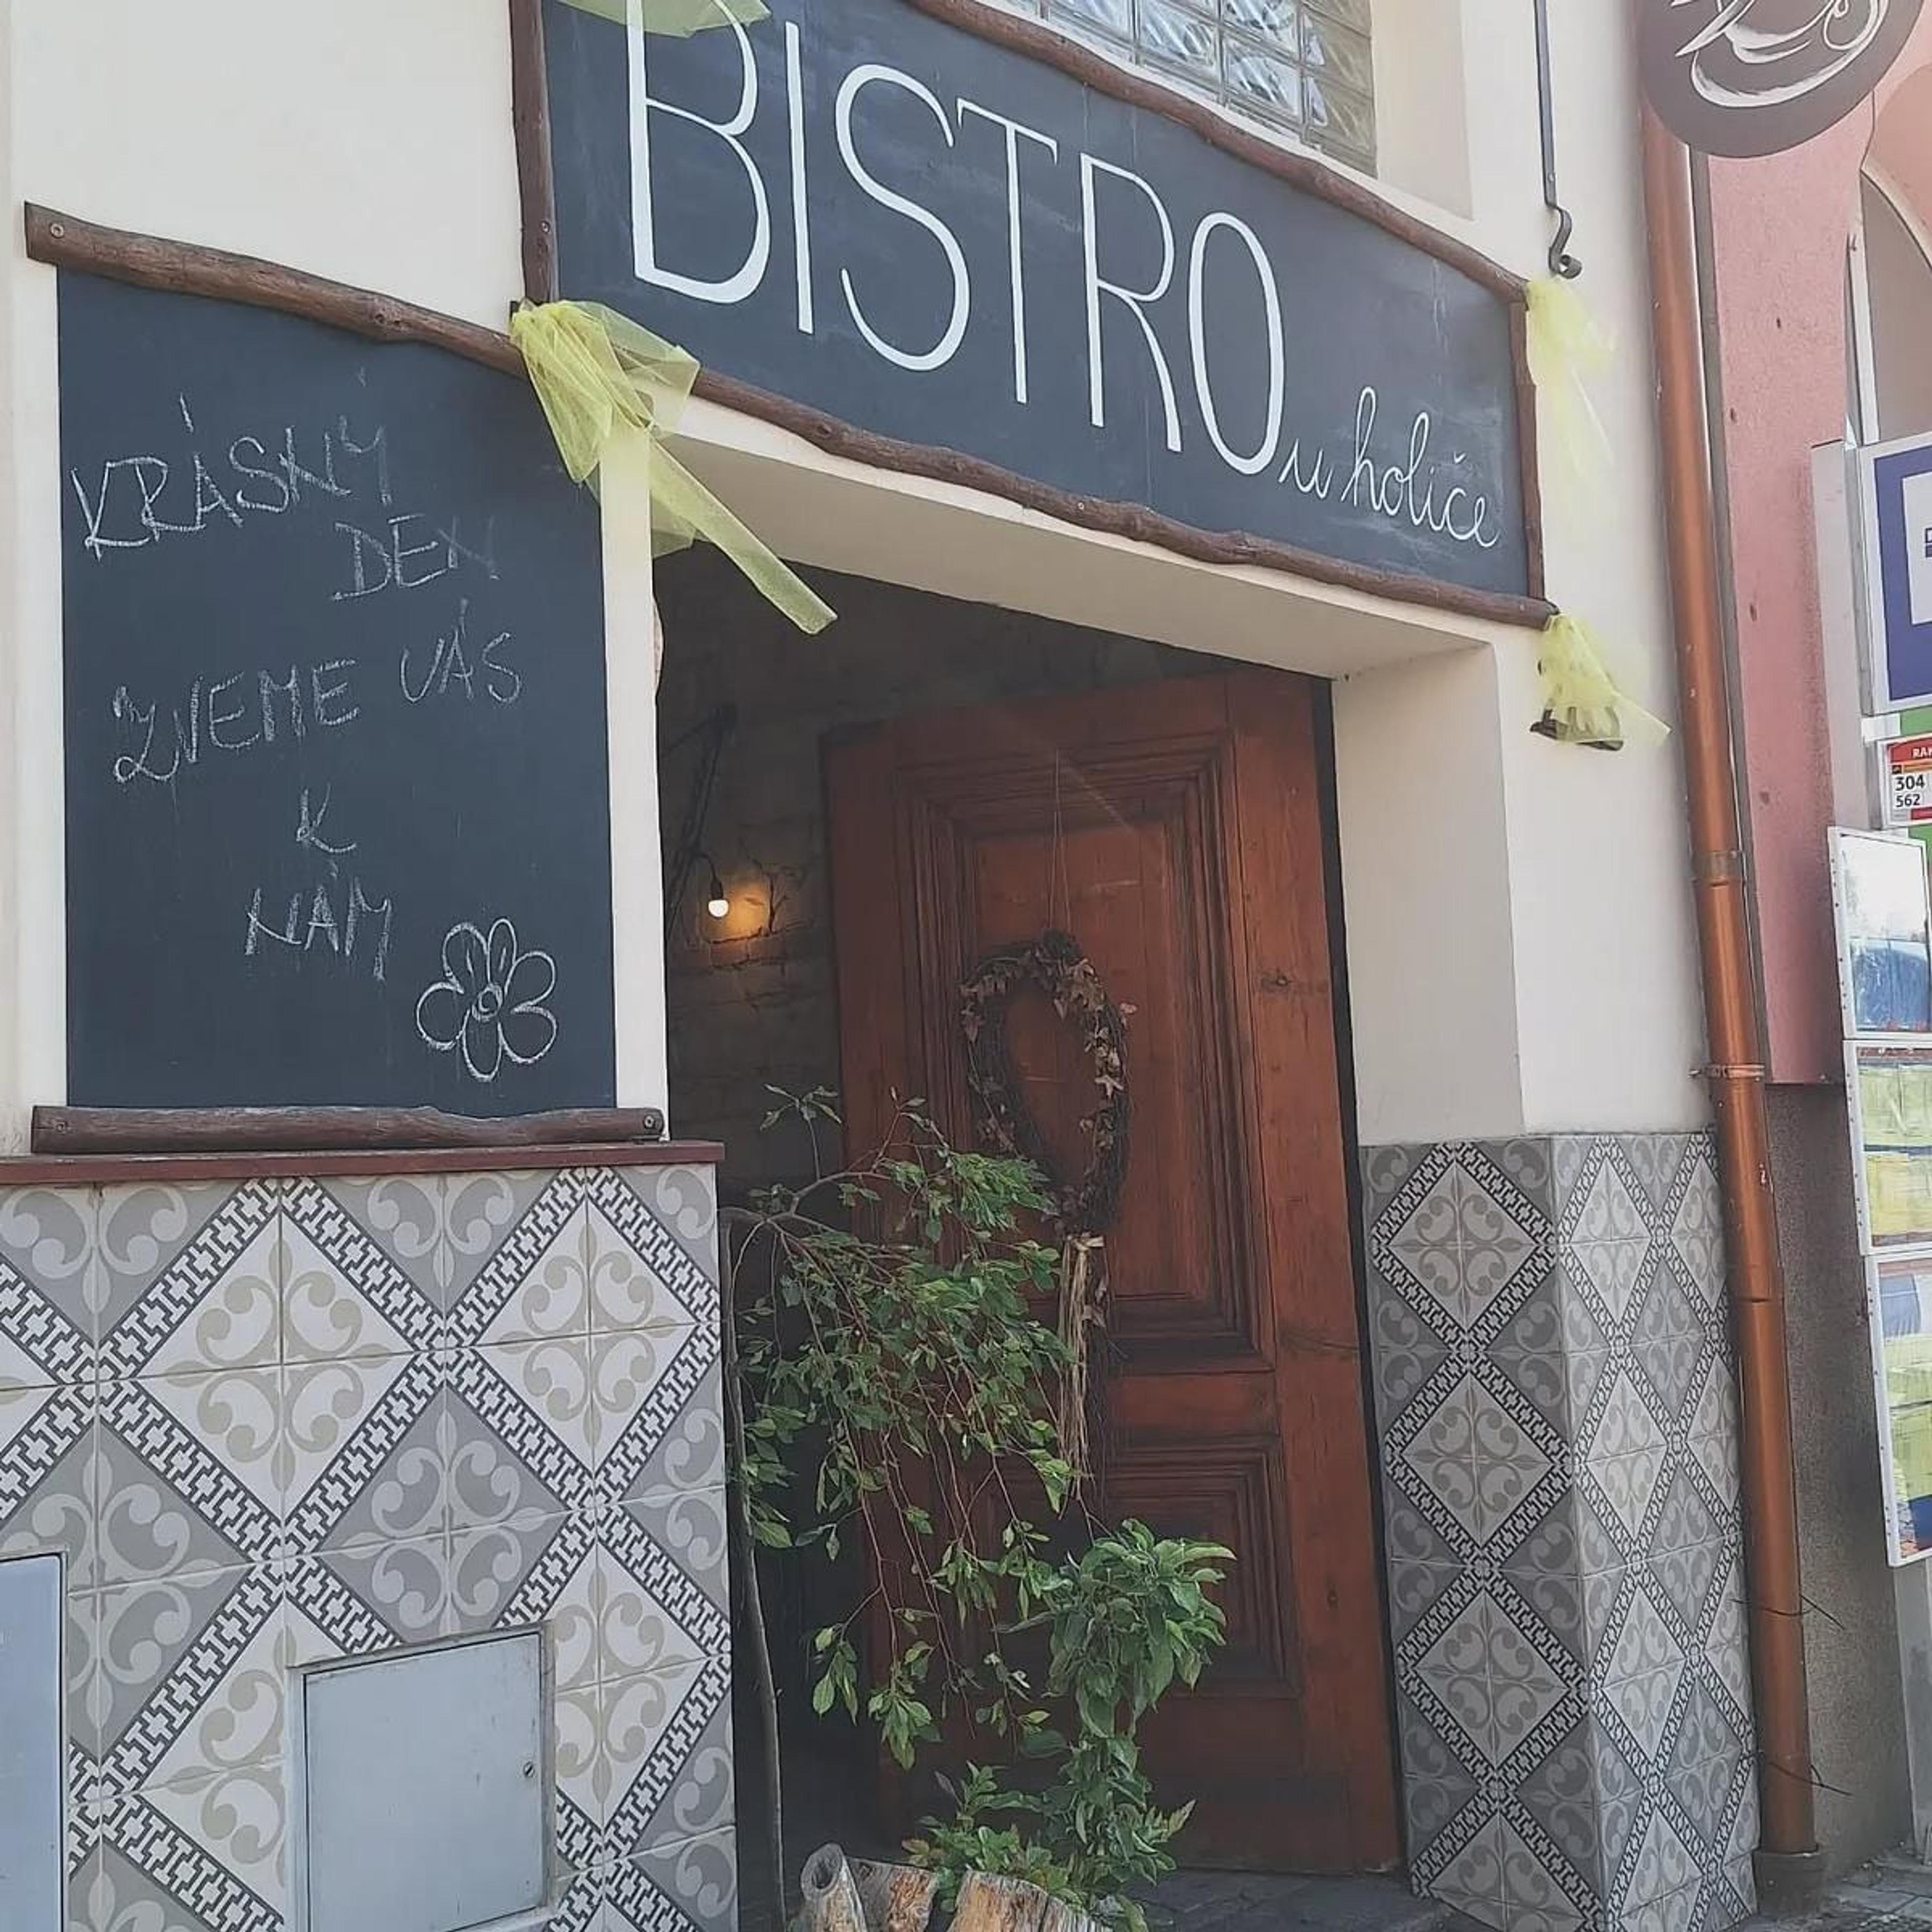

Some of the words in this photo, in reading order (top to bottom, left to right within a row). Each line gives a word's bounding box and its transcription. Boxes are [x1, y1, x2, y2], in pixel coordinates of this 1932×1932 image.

[625, 0, 1285, 475] BISTRO
[1278, 438, 1333, 499] u
[1341, 386, 1500, 547] holiče
[330, 514, 501, 602] DEN
[296, 783, 357, 853] K
[1895, 774, 1925, 791] 304
[1895, 793, 1920, 808] 562
